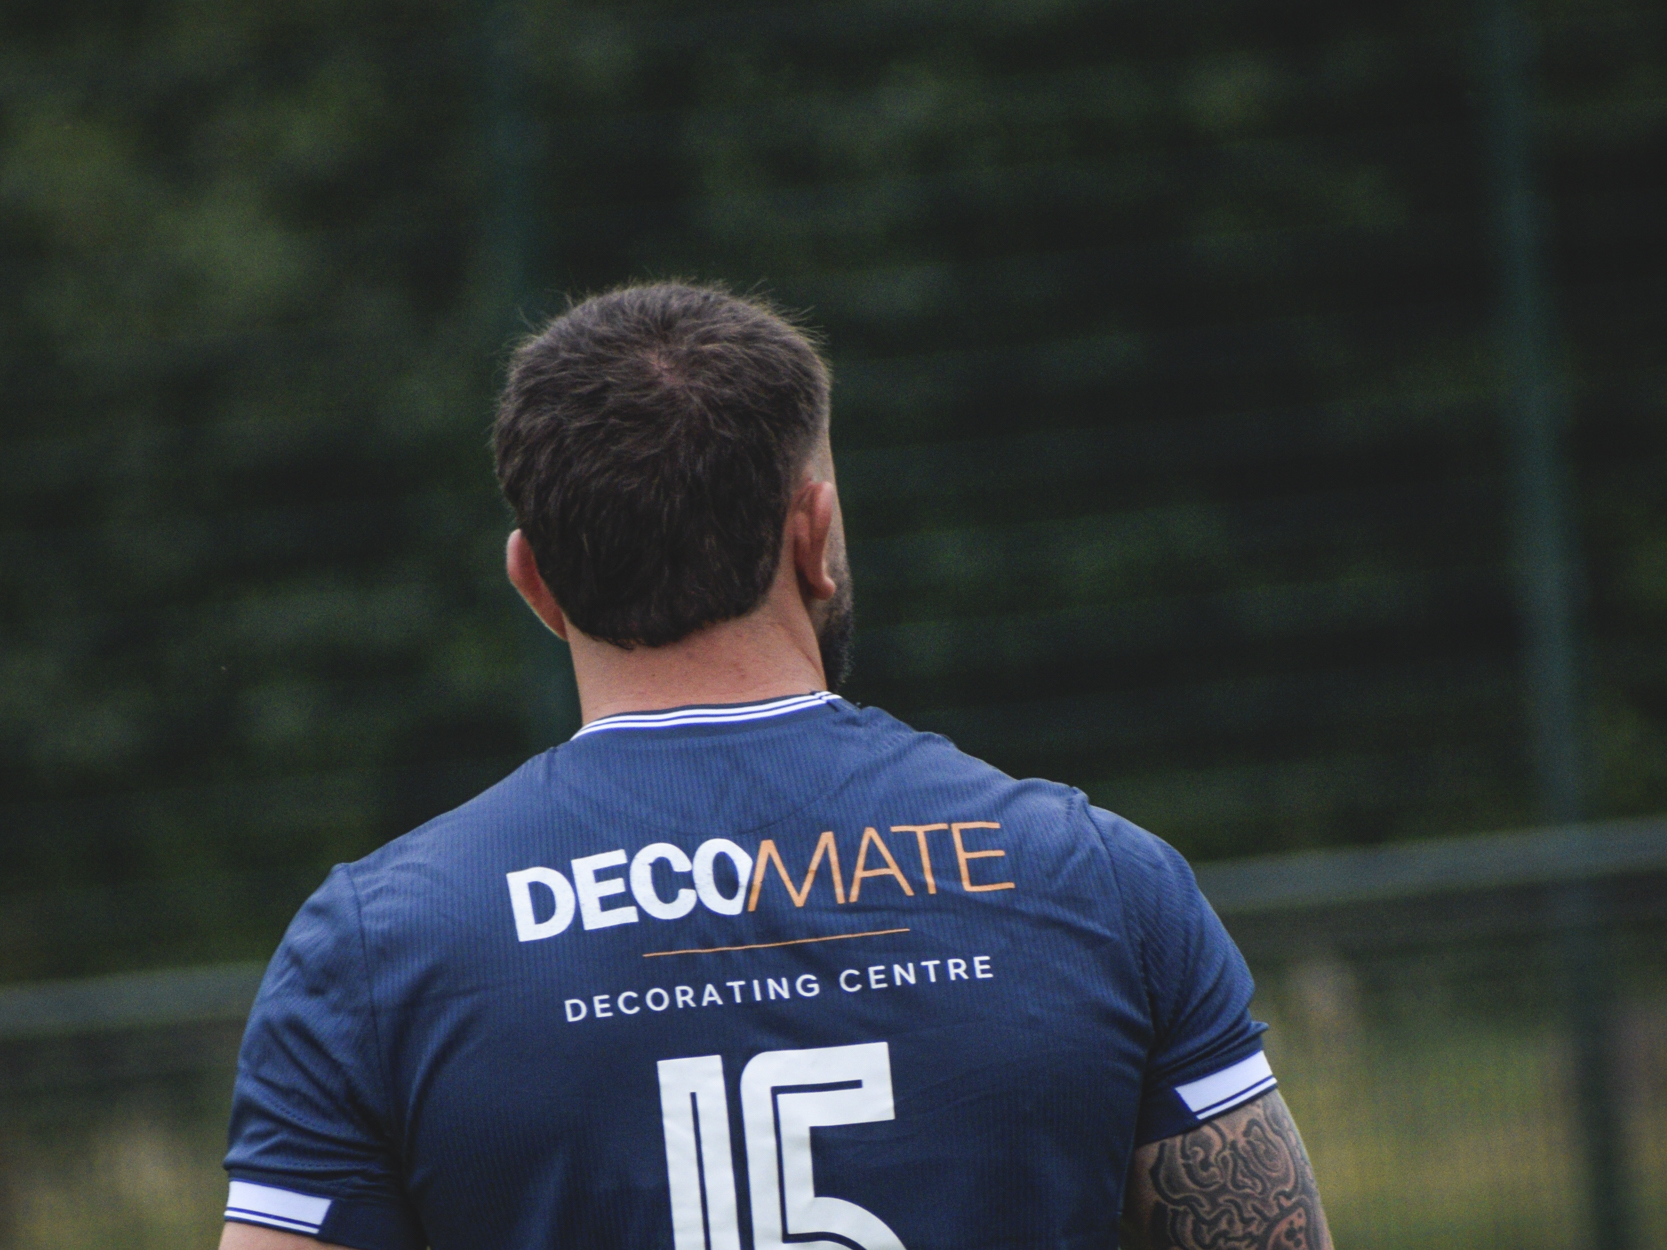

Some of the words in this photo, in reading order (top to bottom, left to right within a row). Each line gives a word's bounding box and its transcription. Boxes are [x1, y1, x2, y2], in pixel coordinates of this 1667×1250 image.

[506, 821, 1016, 942] DECOMATE
[564, 974, 821, 1023] DECORATING
[838, 955, 995, 994] CENTRE
